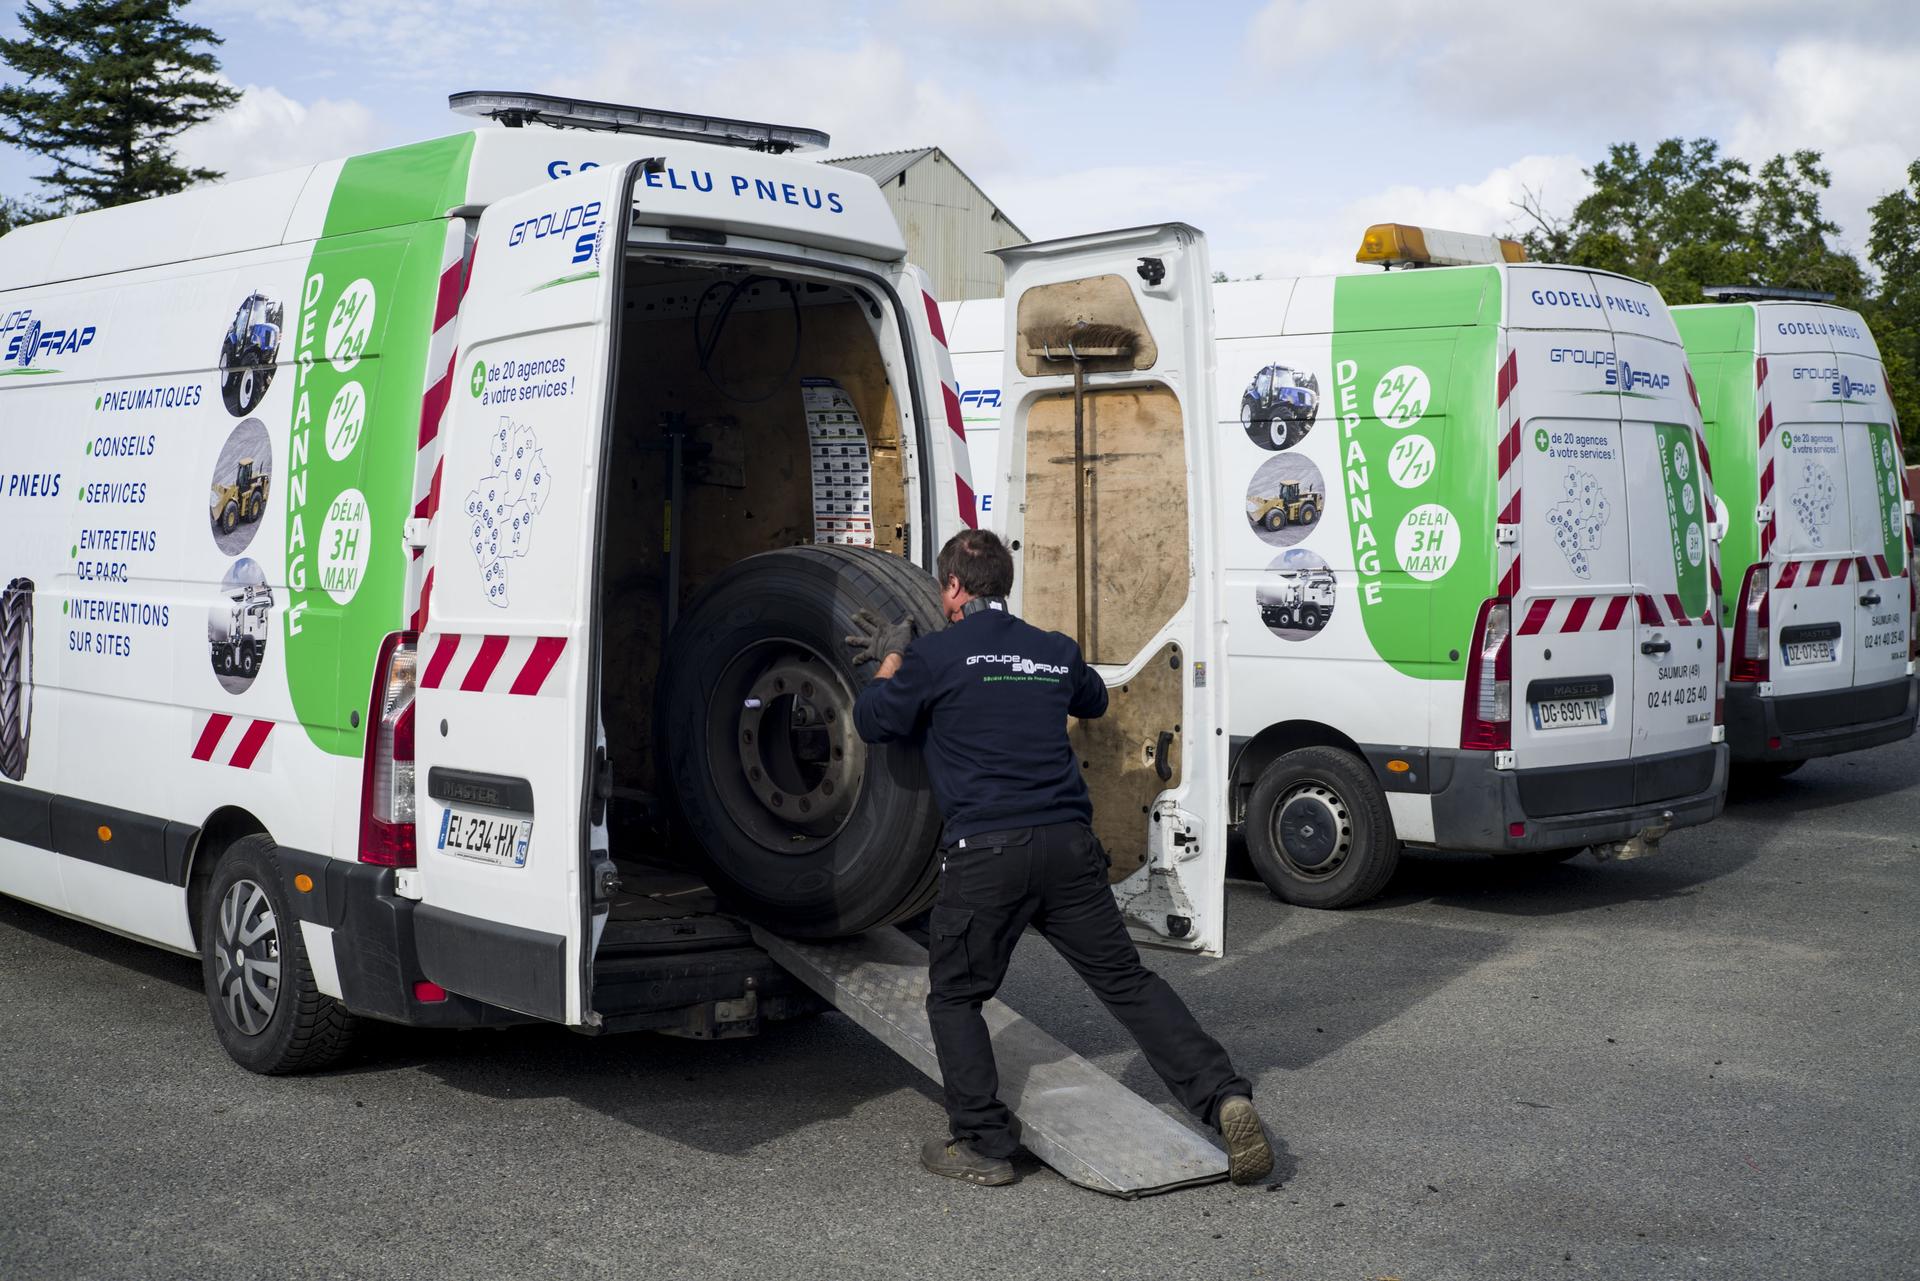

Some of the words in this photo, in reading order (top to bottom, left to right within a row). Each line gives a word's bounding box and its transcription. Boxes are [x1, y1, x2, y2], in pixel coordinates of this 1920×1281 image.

[731, 175, 843, 213] PNEUS
[1532, 290, 1601, 308] GODELU
[1606, 295, 1650, 317] PNEUS
[1778, 323, 1827, 335] GODELU
[1829, 324, 1860, 339] PNEUS
[5, 320, 96, 366] SOFRAP
[488, 364, 500, 382] de
[503, 361, 515, 380] 20
[518, 358, 565, 381] agences
[1605, 360, 1670, 391] SOFRAP
[103, 385, 202, 411] PNEUMATIQUES
[483, 388, 489, 405] à
[491, 385, 516, 404] votre
[519, 380, 567, 400] services
[1832, 375, 1876, 398] SOFRAP
[94, 435, 155, 457] CONSEILS
[1552, 433, 1562, 443] de
[1564, 433, 1574, 444] 20
[1576, 436, 1608, 447] agences
[289, 272, 324, 636] DEPANNAGE
[1557, 447, 1578, 458] votre
[1580, 448, 1611, 459] services
[9, 473, 61, 497] PNEUS
[86, 483, 147, 504] SERVICES
[1336, 359, 1383, 606] DEPANNAGE
[330, 499, 364, 521] DÉLAI
[1658, 434, 1683, 577] DEPANNAGE
[1408, 510, 1448, 526] DÉLAI
[80, 530, 156, 551] ENTRETIENS
[330, 528, 360, 560] 3H
[1411, 530, 1444, 552] 3H
[77, 561, 93, 581] DE
[96, 562, 128, 583] PARC
[1405, 555, 1447, 571] MAXI
[324, 567, 358, 591] MAXI
[70, 599, 169, 627] INTERVENTIONS
[69, 631, 91, 652] SUR
[96, 634, 130, 656] SITES
[1012, 659, 1069, 674] SOFRAP
[1659, 665, 1688, 680] SAUMUR
[1553, 684, 1598, 696] MASTER
[1648, 692, 1659, 708] 02
[1661, 690, 1671, 706] 41
[1674, 688, 1685, 704] 40
[1687, 687, 1696, 703] 25
[1698, 685, 1707, 701] 40
